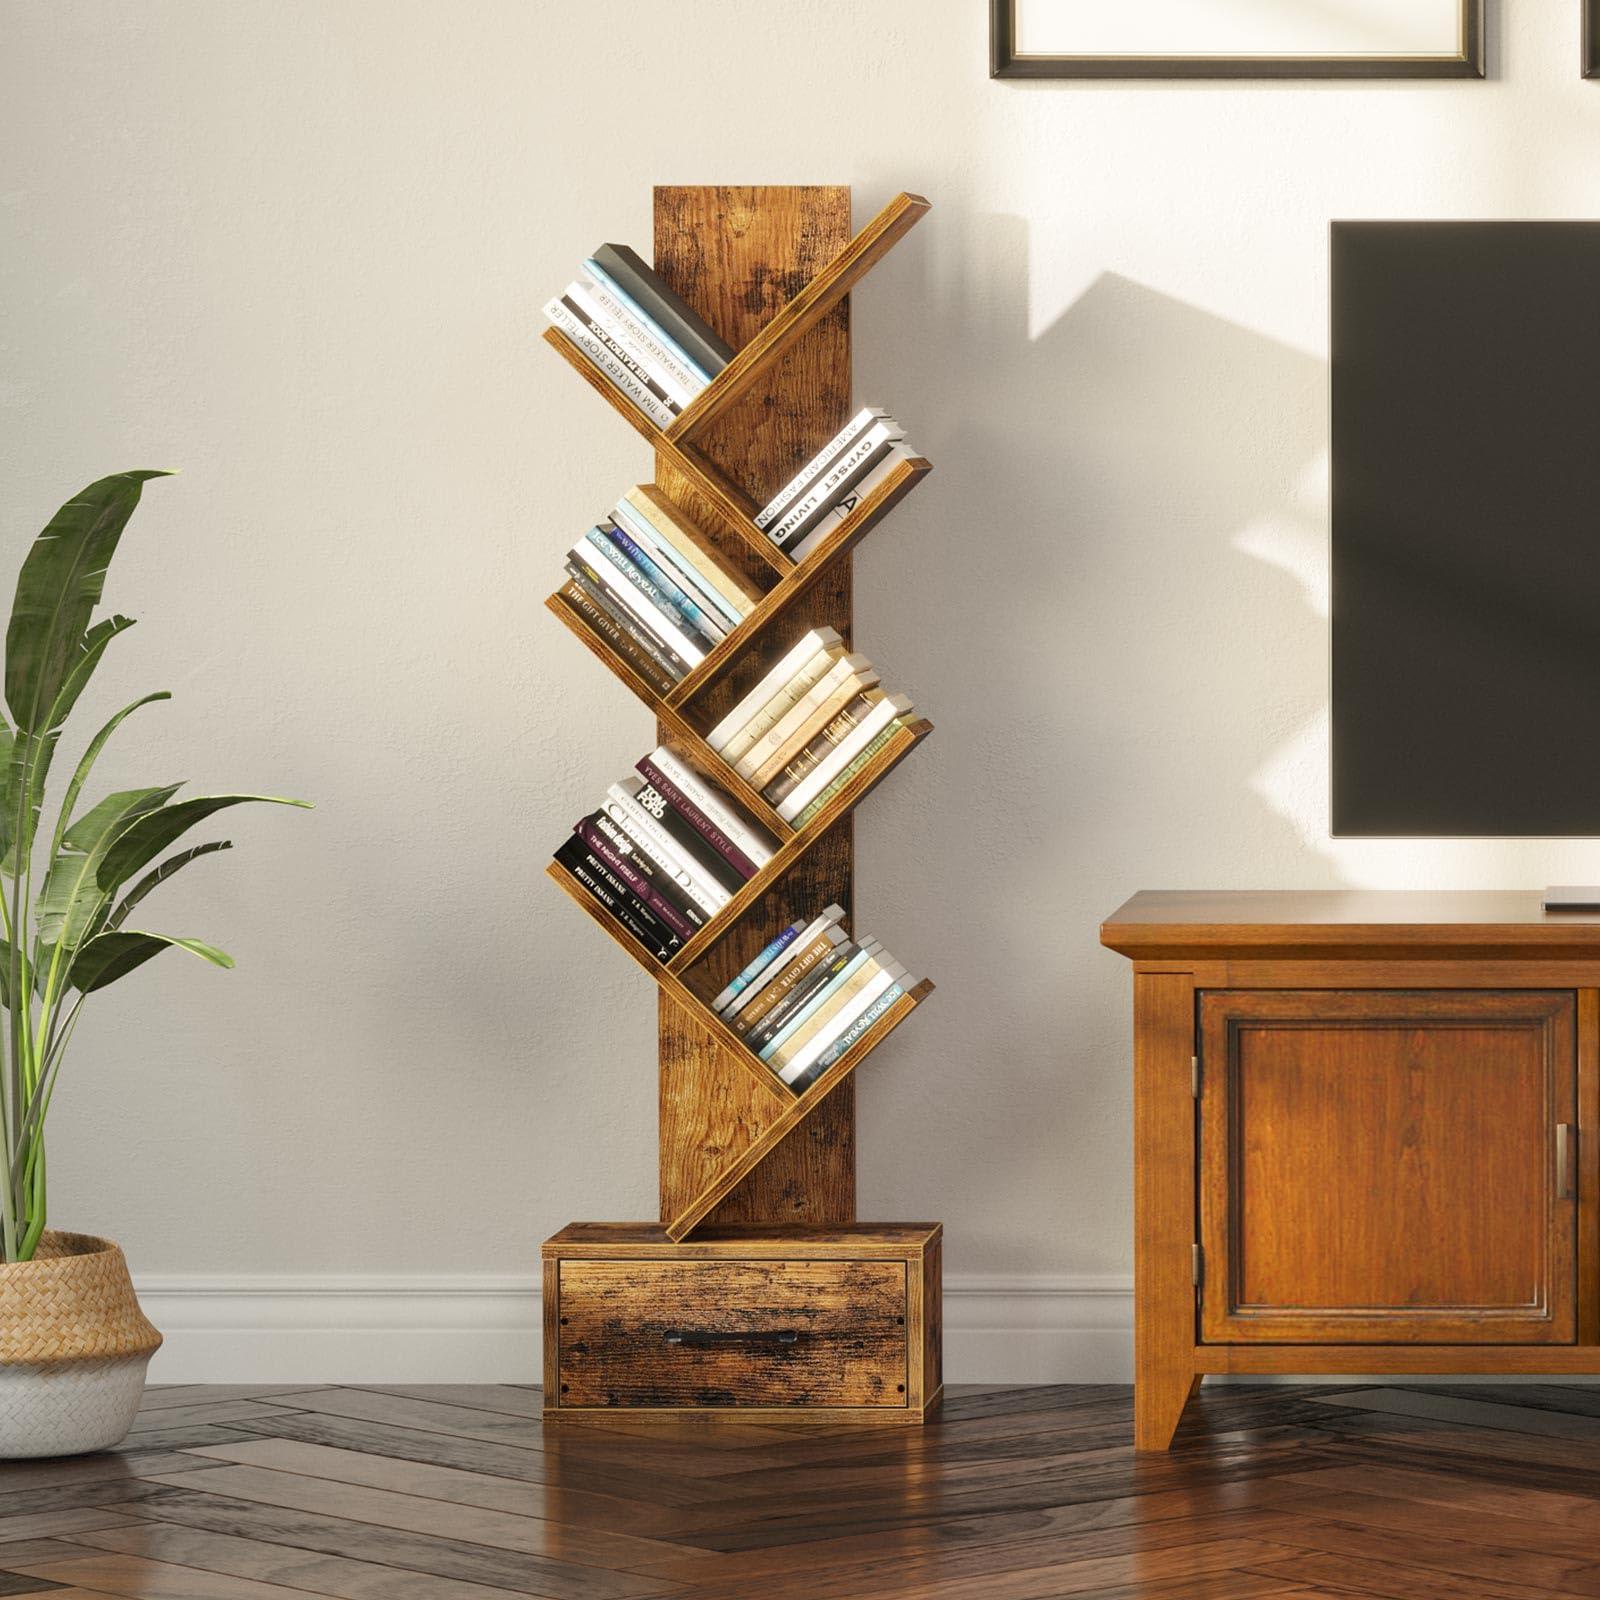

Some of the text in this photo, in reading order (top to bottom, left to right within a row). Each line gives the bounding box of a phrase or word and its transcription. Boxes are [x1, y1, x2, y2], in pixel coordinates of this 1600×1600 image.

[549, 304, 580, 335] TELLER
[587, 320, 608, 341] BOOK
[577, 332, 608, 363] STORY
[605, 338, 637, 370] PLAYBOY
[605, 359, 644, 398] WALKER
[634, 367, 651, 383] THE
[640, 395, 659, 413] TIM
[756, 422, 858, 525] AMERICAN FASHION
[774, 440, 873, 539] GYPSET LIVING
[566, 586, 584, 603] THE
[581, 600, 600, 619] GIFT
[596, 616, 620, 640] GIVER
[635, 790, 665, 820] FORD
[641, 784, 667, 809] TOM
[643, 765, 662, 784] YVES
[660, 782, 682, 804] SAINT
[679, 801, 711, 832] LAURENT
[709, 831, 732, 854] STYLE
[589, 834, 603, 848] THE
[600, 845, 621, 866] NIGHT
[618, 863, 638, 883] ITSELF
[605, 801, 673, 869] Christian
[674, 869, 710, 905] Dior
[574, 865, 615, 906] PRETTY INSANE
[585, 853, 607, 876] PRETTY
[605, 873, 627, 895] INSANE
[797, 952, 815, 970] GIFT
[810, 940, 827, 956] THE
[779, 966, 801, 988] GIVER
